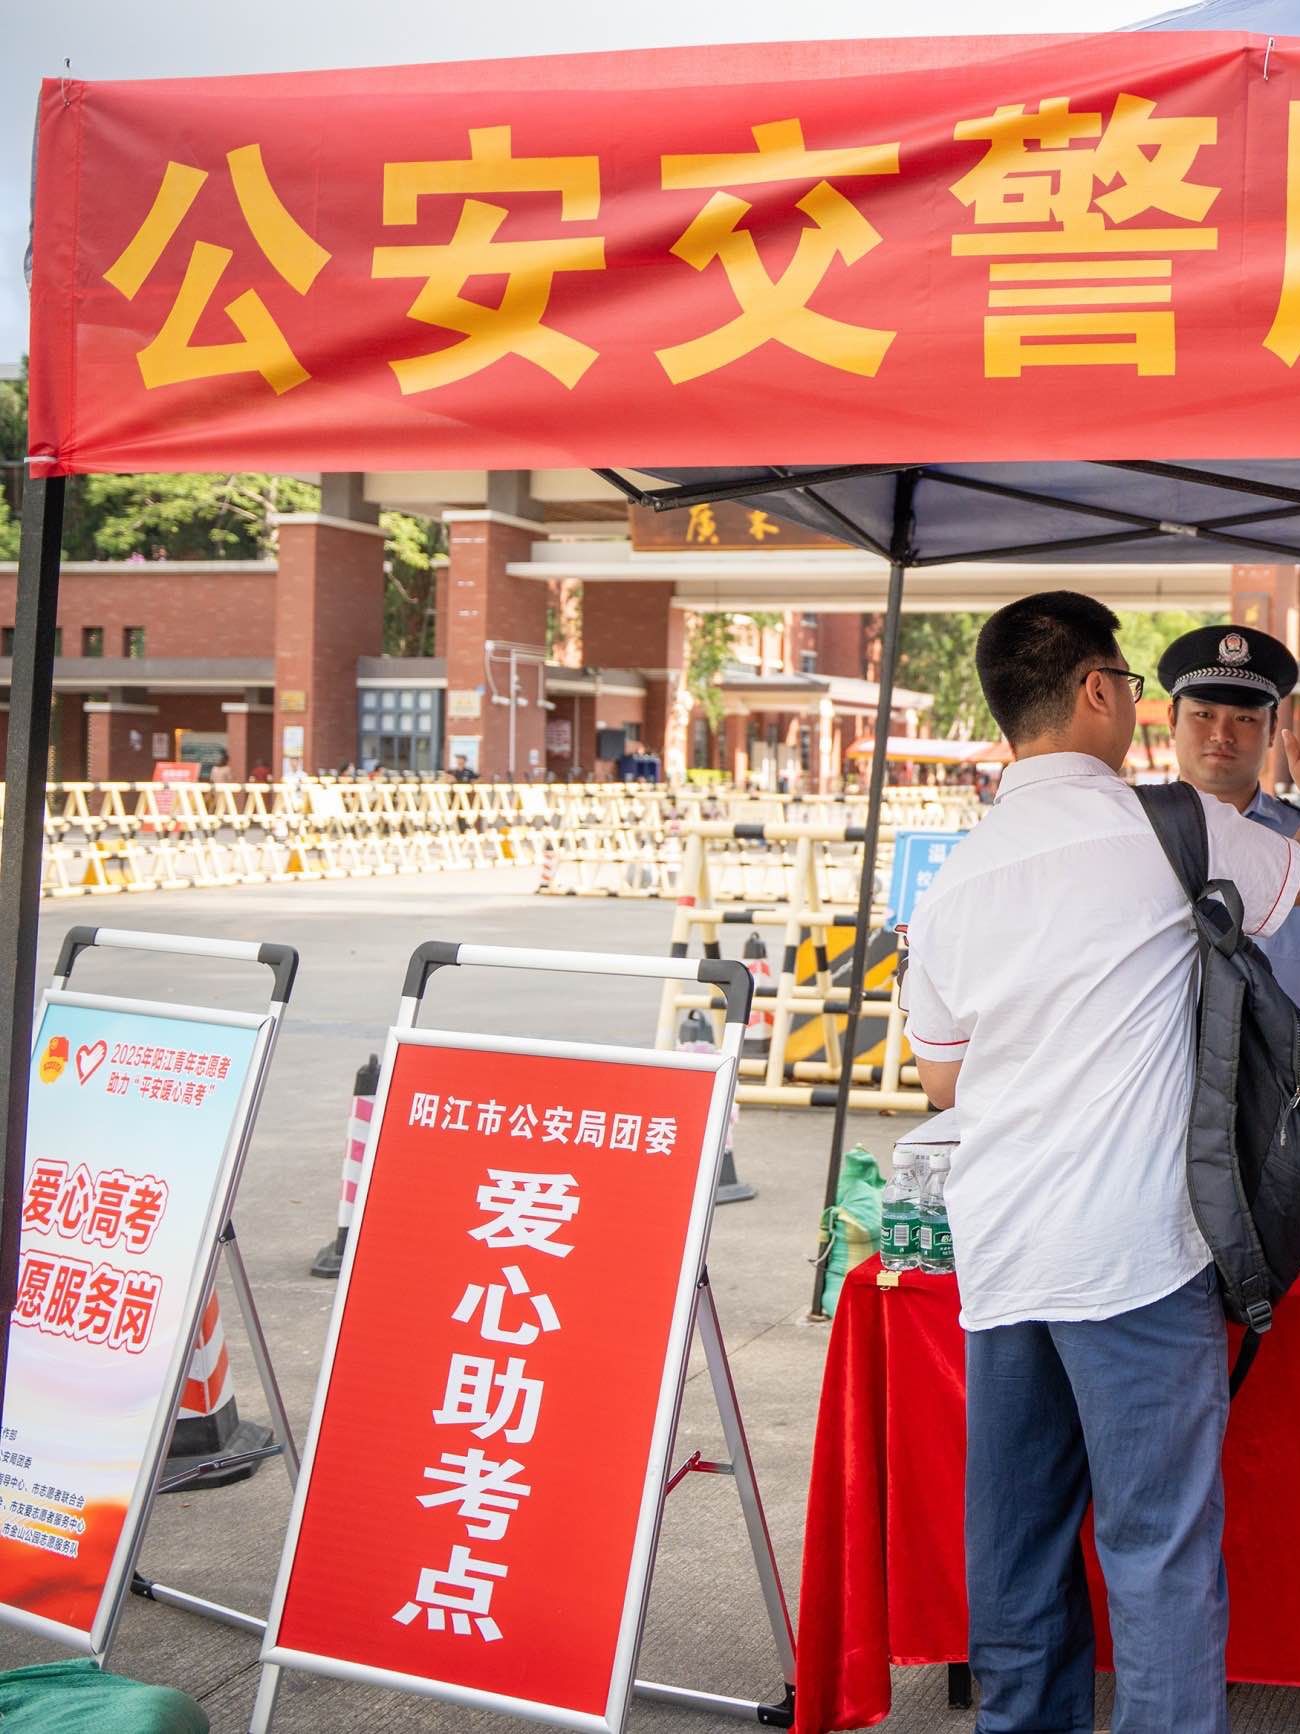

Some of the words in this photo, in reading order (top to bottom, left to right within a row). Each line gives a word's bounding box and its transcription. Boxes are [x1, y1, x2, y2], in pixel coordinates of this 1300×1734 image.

[110, 1043, 232, 1081] 2025年阳江青年志愿者
[408, 1092, 678, 1156] 阳江市公安局团委
[22, 1165, 165, 1246] 爱心高考
[15, 1256, 159, 1346] 愿服务岗
[391, 1168, 581, 1643] 爱心助考点
